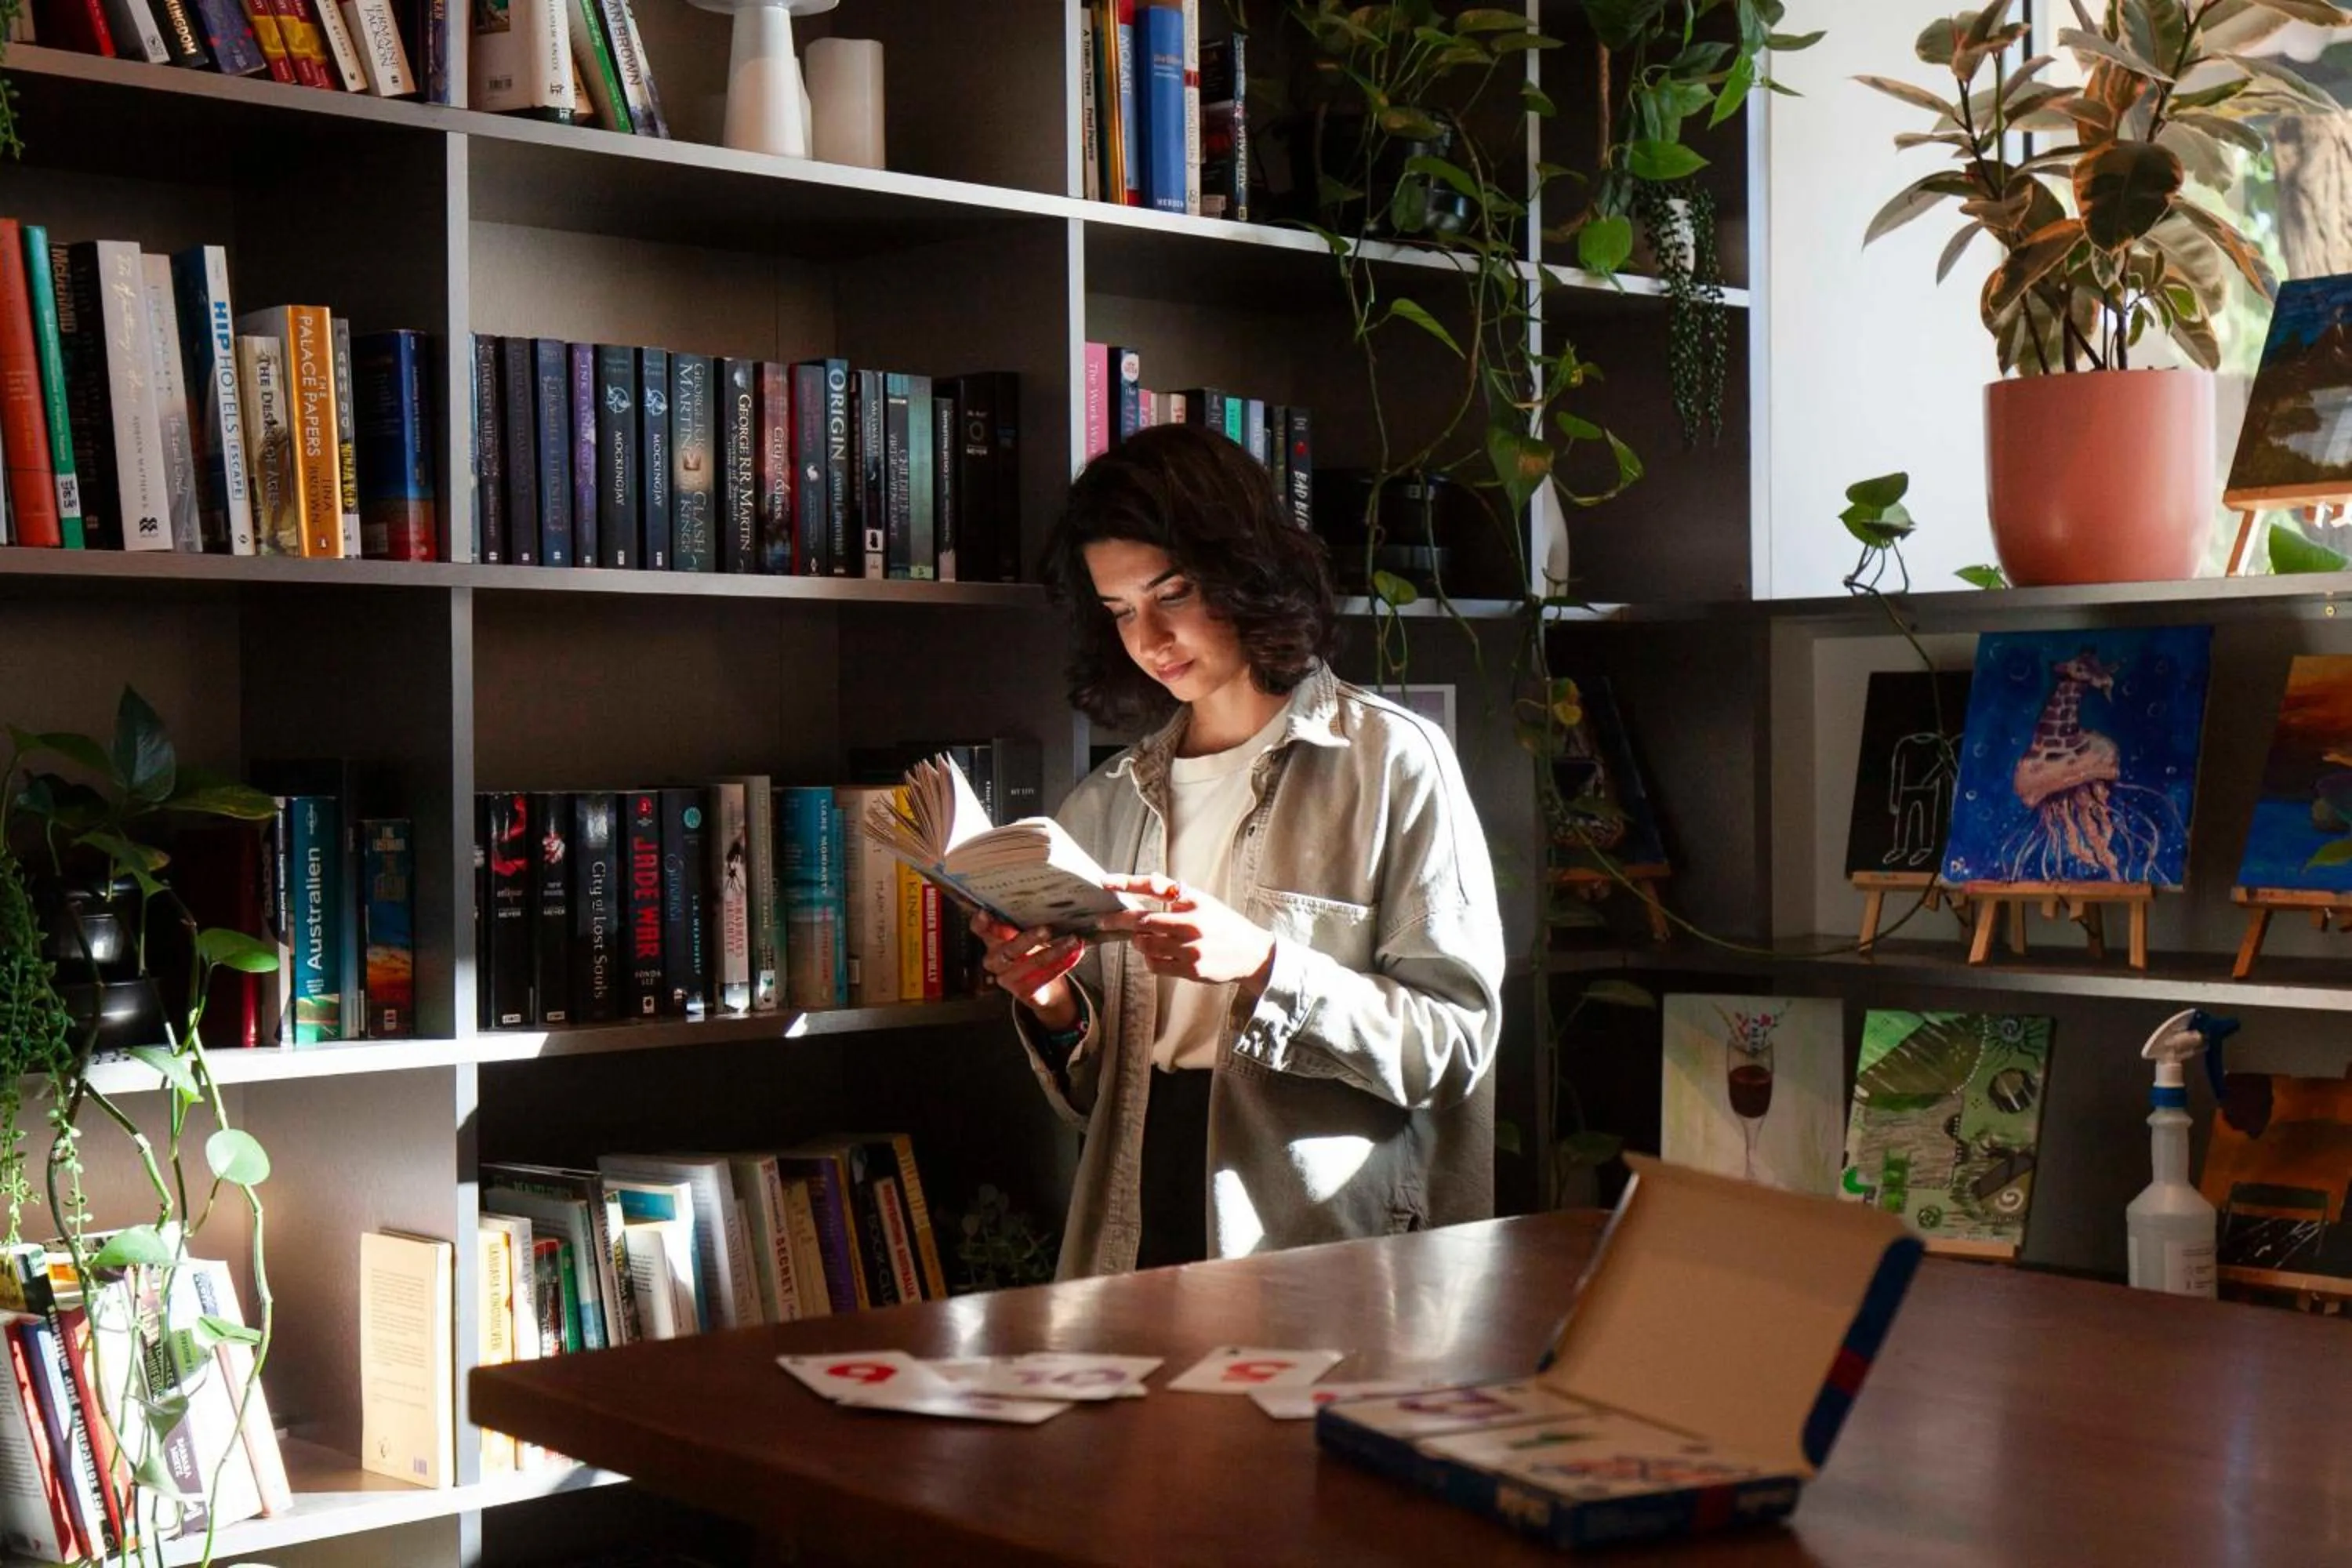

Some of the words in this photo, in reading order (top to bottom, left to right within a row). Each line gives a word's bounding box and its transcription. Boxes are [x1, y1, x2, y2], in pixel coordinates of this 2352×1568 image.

[365, 8, 388, 67] JACKSON
[377, 3, 401, 72] JERMAINE
[609, 24, 642, 86] BROWN
[1120, 34, 1133, 96] MOZART
[213, 301, 234, 350] HIP
[299, 315, 318, 387] PALACE
[217, 354, 241, 434] HOTELS
[693, 363, 706, 422] GEORGE
[1088, 361, 1099, 385] The
[303, 390, 322, 457] PAPERS
[679, 363, 695, 452] MARTIN
[737, 394, 753, 455] GEORGE
[828, 368, 846, 461] ORIGIN
[1089, 389, 1100, 419] Work
[228, 444, 245, 497] ESCAPE
[613, 430, 626, 506] MOCKINGJAY
[652, 433, 664, 507] MOCKINGJAY
[772, 426, 786, 459] City
[321, 479, 336, 512] TINA
[773, 477, 788, 518] Glass
[1294, 470, 1309, 499] BAD
[680, 499, 692, 554] KINGS
[692, 491, 708, 554] CLASH
[739, 488, 754, 552] MARTIN
[1294, 500, 1310, 535] BLO
[590, 861, 608, 895] City
[632, 835, 662, 900] JADE
[819, 836, 831, 895] MORIARTY
[305, 847, 324, 957] Australien
[633, 903, 661, 960] WAR
[906, 881, 920, 927] KING
[925, 887, 938, 929] MURDER
[593, 916, 608, 949] Lost
[592, 954, 608, 1000] Souls
[775, 1236, 793, 1296] SECRET
